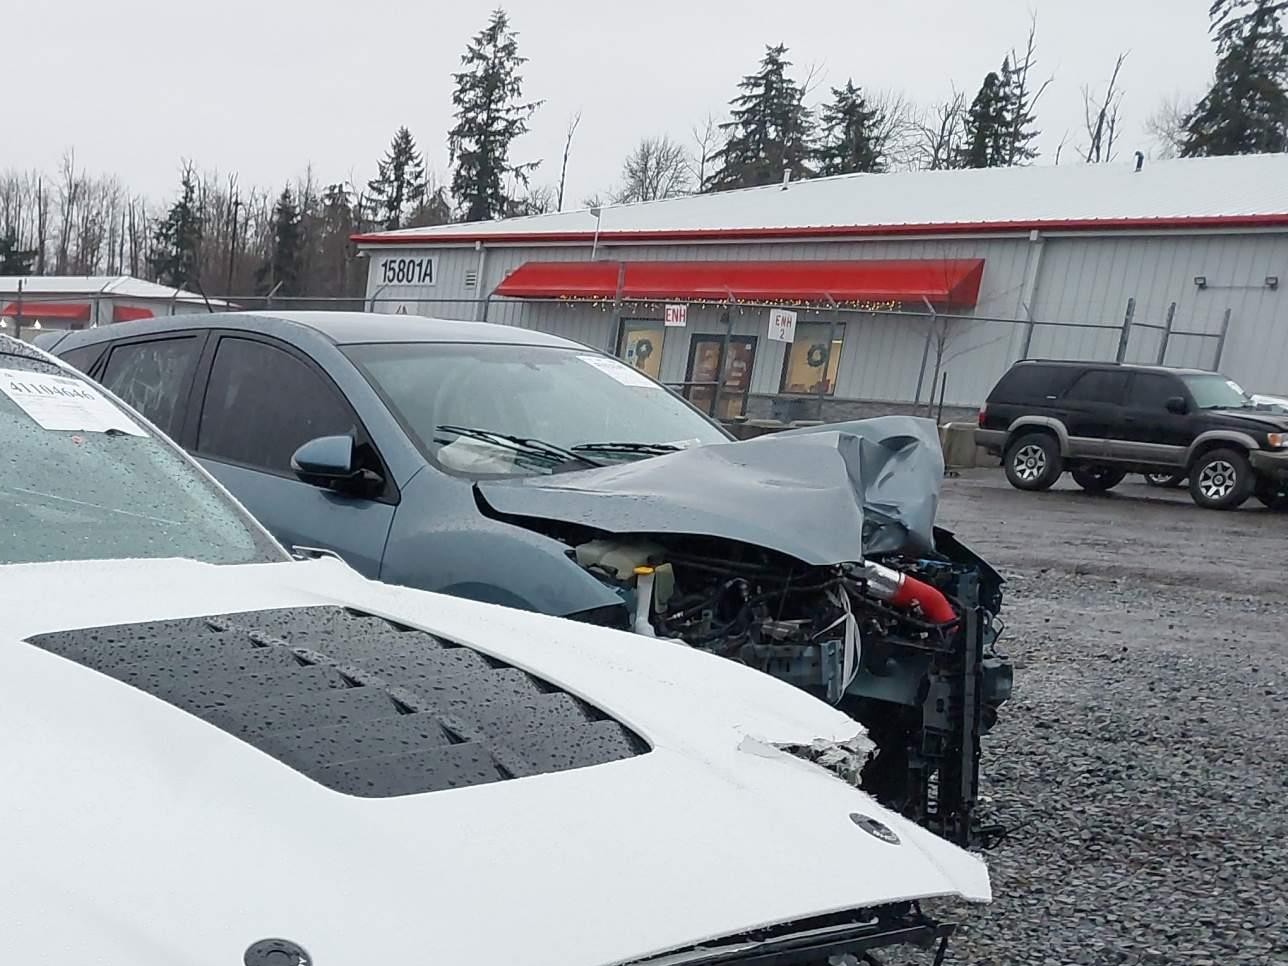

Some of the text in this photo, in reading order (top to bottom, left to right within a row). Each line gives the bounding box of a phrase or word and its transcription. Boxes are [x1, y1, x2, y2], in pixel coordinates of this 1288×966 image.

[381, 259, 433, 283] 15801A
[666, 308, 686, 323] ENH
[775, 314, 792, 327] ENH
[779, 328, 786, 340] 2
[9, 381, 96, 401] 41104646
